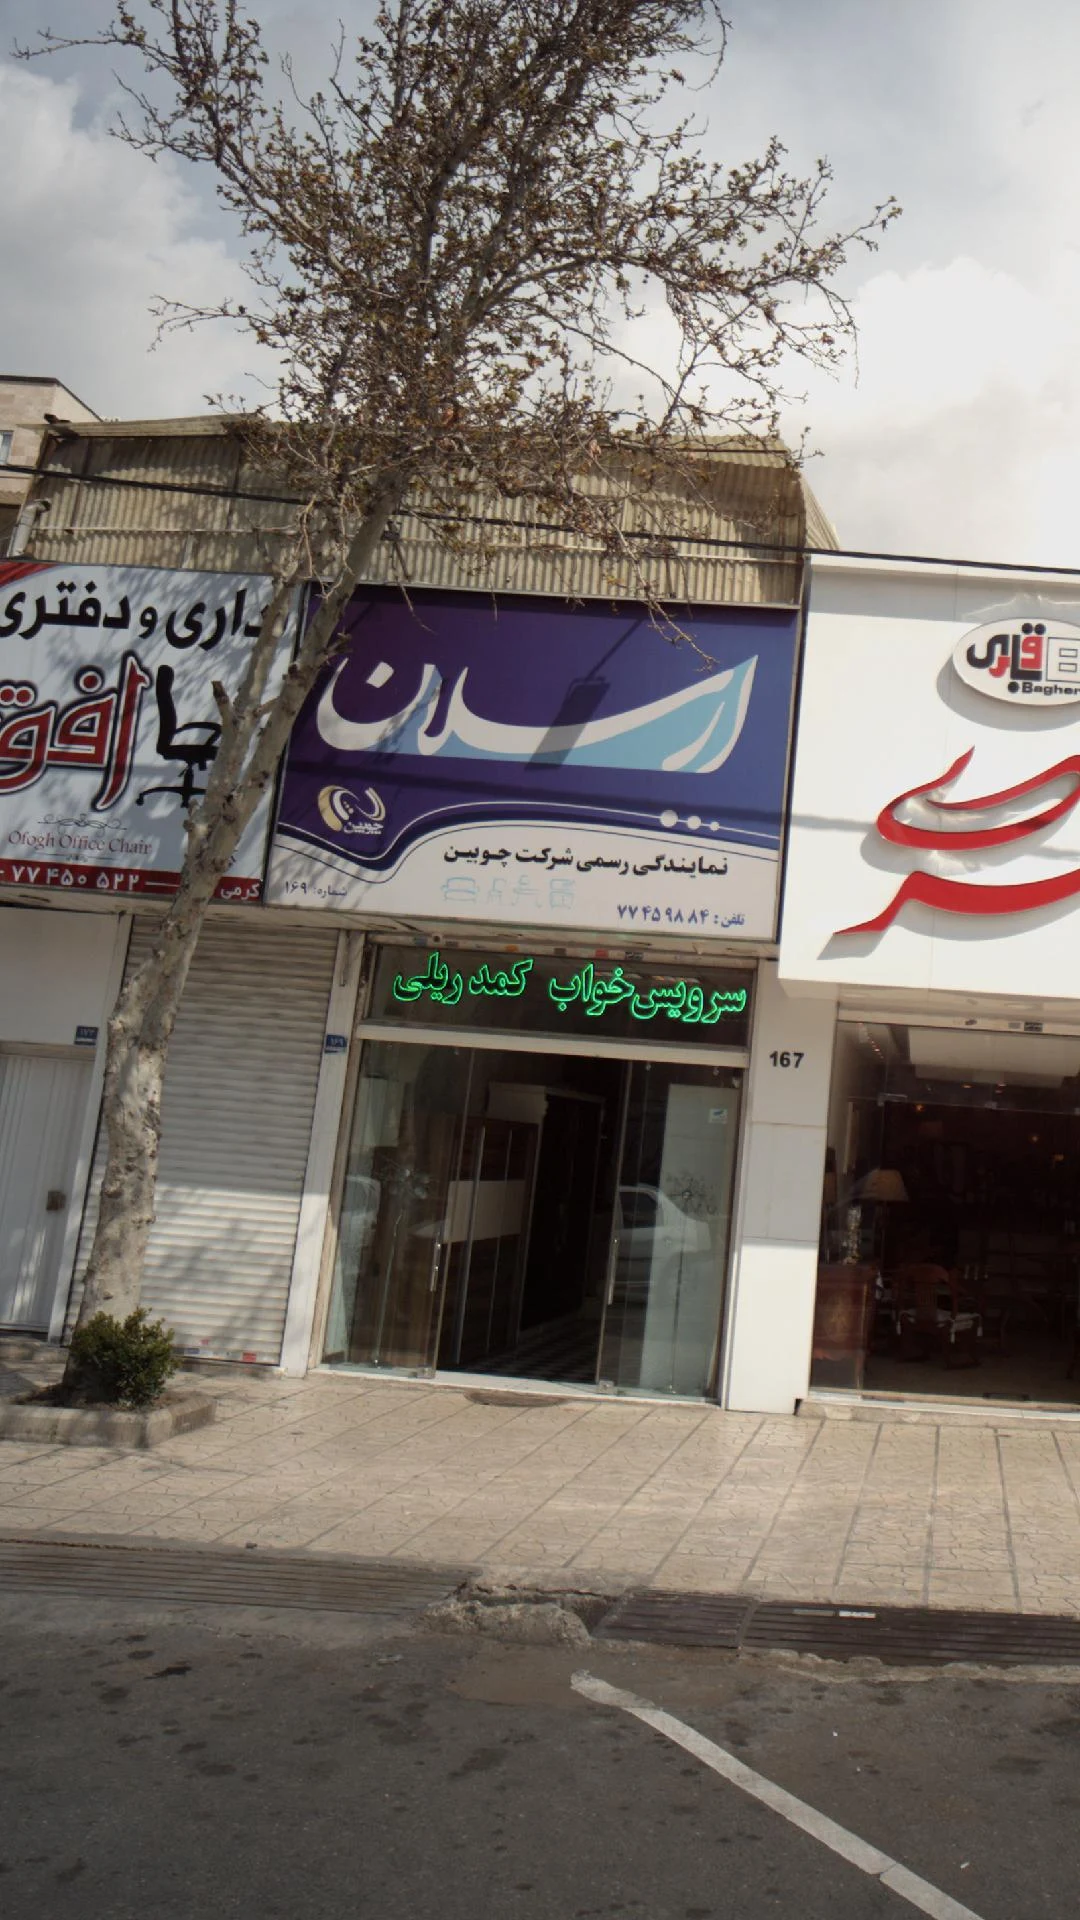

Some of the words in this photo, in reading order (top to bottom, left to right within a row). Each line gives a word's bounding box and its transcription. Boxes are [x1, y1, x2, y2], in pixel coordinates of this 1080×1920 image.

[139, 606, 157, 639] و
[8, 830, 56, 850] Ofogh
[58, 834, 105, 851] Office
[108, 838, 152, 855] Chair
[443, 846, 513, 868] چوبین
[515, 847, 574, 871] شرکت
[576, 855, 629, 876] رسمی
[633, 854, 729, 879] نمایندگی
[392, 951, 463, 1005] ریلی
[468, 958, 534, 997] کمد
[549, 963, 635, 1016] خواب
[631, 980, 748, 1024] سرویس
[769, 1050, 805, 1069] 167
